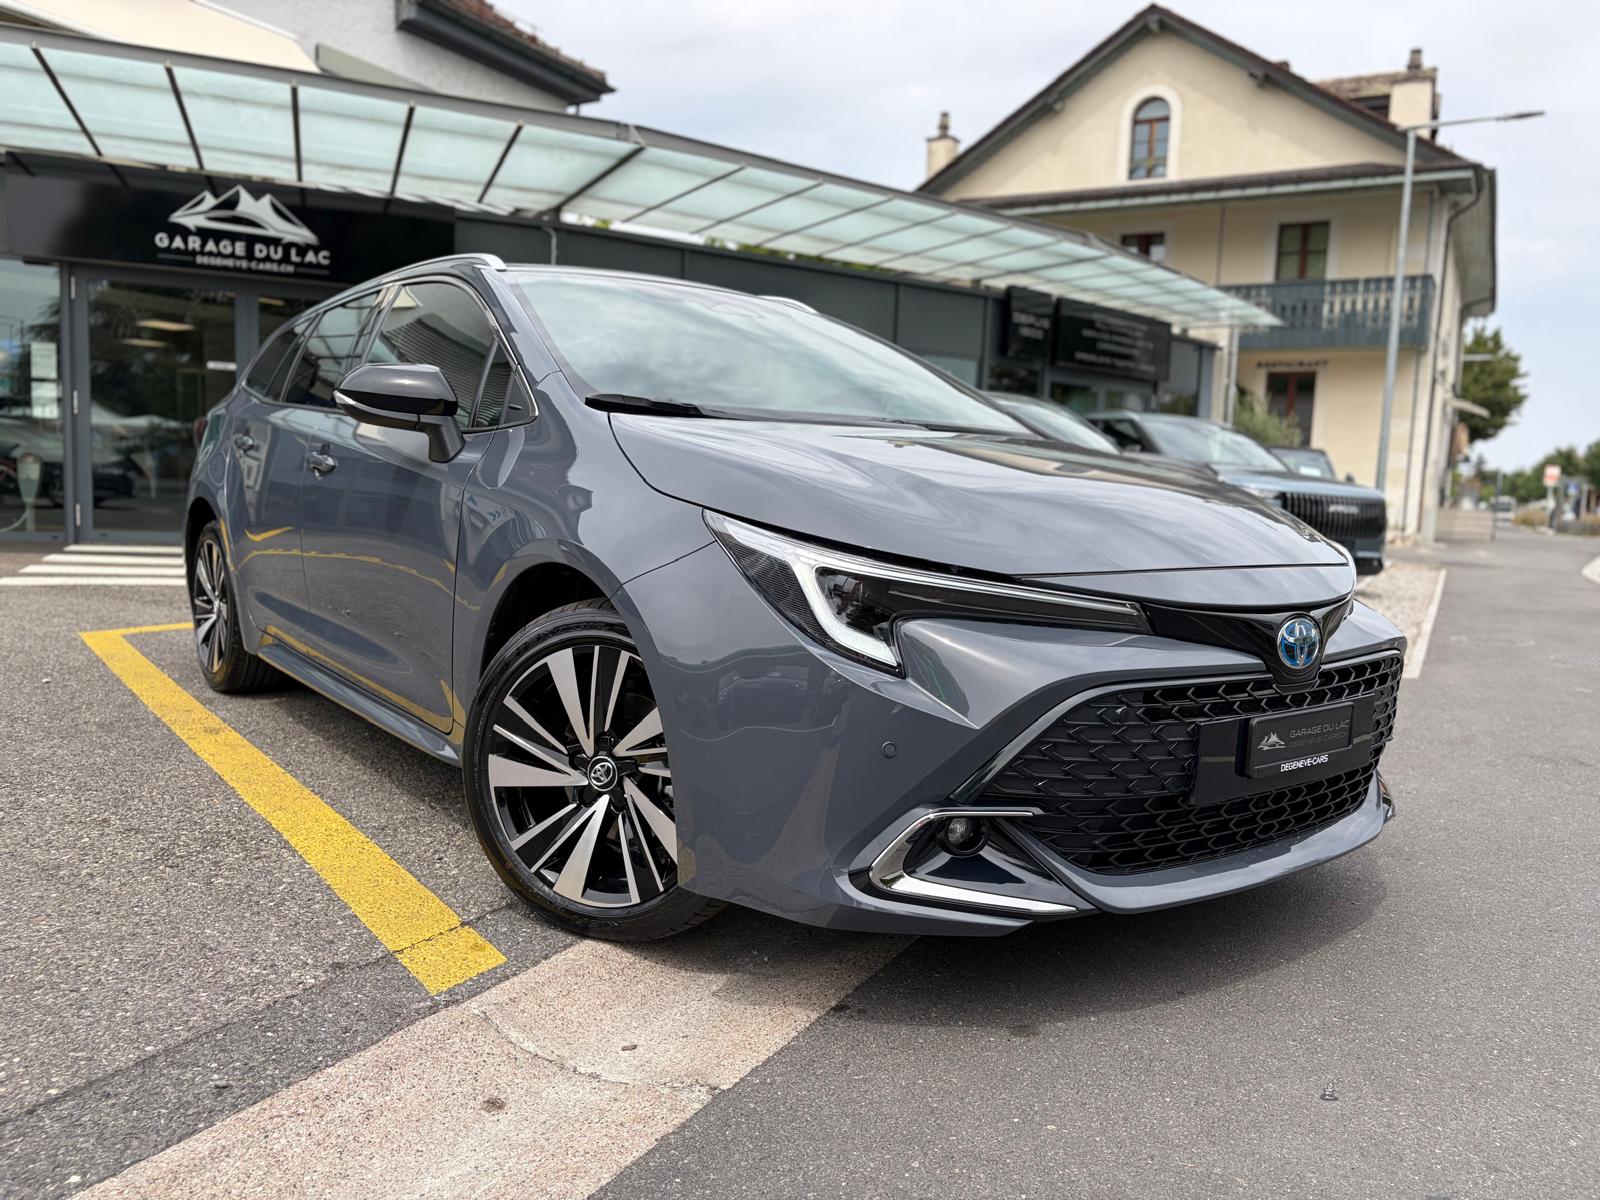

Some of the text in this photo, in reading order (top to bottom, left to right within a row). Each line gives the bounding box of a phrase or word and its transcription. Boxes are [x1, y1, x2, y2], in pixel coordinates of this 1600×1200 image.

[154, 231, 331, 265] GARAGE DU LAC
[1290, 719, 1350, 738] GARAGE DU LAC
[1280, 754, 1329, 772] DEGENEVE-CARS
